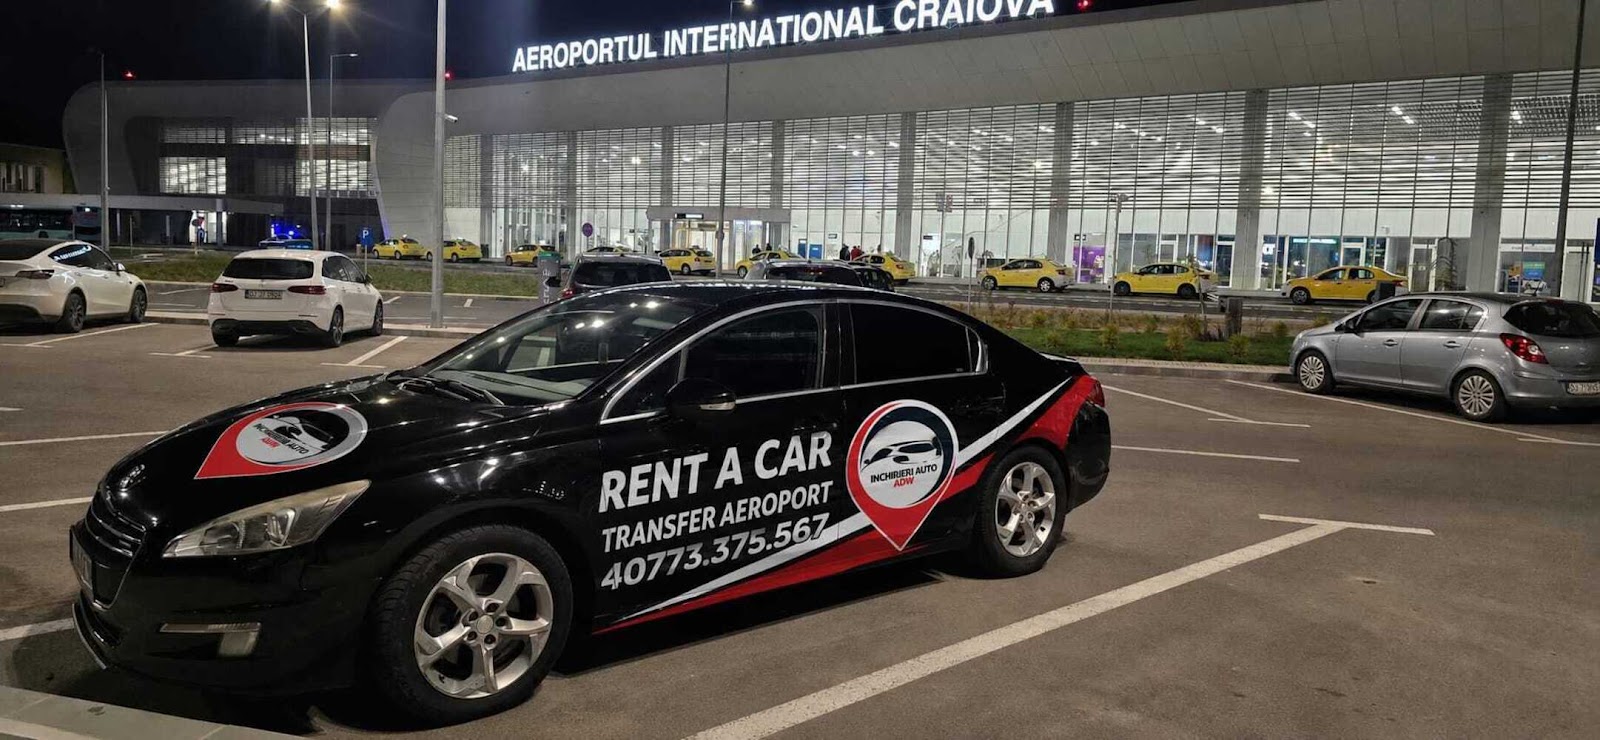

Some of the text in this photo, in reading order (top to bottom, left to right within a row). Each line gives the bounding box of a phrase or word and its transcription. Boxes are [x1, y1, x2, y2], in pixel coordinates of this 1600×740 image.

[512, 32, 657, 72] AEROPORTUL
[664, 4, 885, 57] INTERNATIONAL
[362, 229, 369, 239] P
[598, 431, 832, 513] RENT A CAR
[870, 464, 938, 483] INCHIRIERI AUTO
[894, 476, 914, 487] ADW
[602, 480, 833, 552] TRANSFER AEROPORT
[601, 512, 830, 590] 40773.375.567
